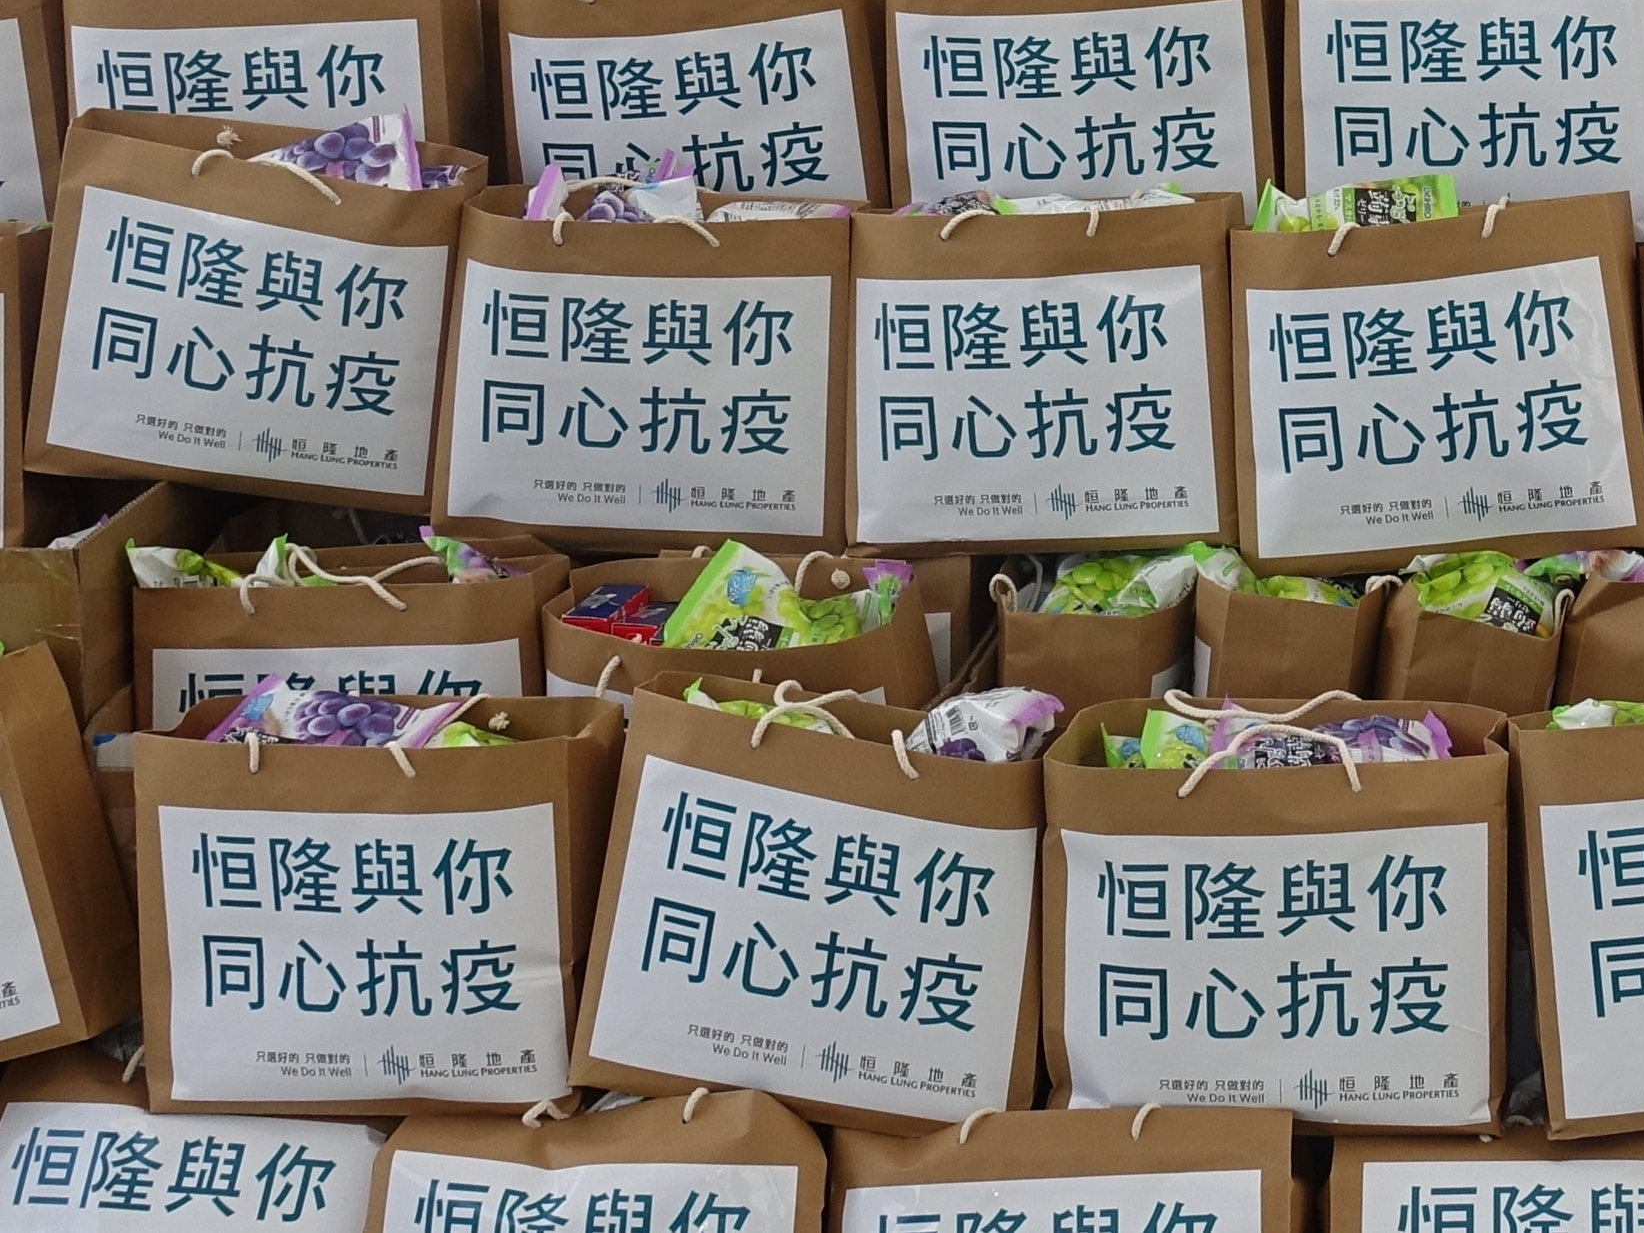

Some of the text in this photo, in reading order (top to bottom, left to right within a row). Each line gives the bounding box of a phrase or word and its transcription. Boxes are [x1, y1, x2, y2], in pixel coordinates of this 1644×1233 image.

[97, 44, 385, 112] 恒隆與你
[531, 41, 816, 121] 恒隆與你
[924, 26, 1211, 99] 恒隆與你
[1328, 16, 1617, 83] 恒隆與你
[932, 107, 1219, 182] 同心抗疫
[1334, 101, 1621, 168] 同心抗疫
[106, 216, 407, 329] 恒隆與你
[92, 307, 399, 416] 同心抗疫
[483, 289, 793, 366] 恒隆與你
[875, 295, 1167, 371] 恒隆與你
[1270, 290, 1573, 382] 恒隆與你
[482, 380, 790, 455] 同心抗疫
[880, 384, 1174, 461] 同心抗疫
[1279, 379, 1588, 473] 同心抗疫
[558, 493, 574, 502] We
[577, 494, 592, 503] Do
[604, 495, 626, 504] Well
[692, 487, 795, 503] 恒隆地產
[692, 500, 796, 511] HANG LUNG PROPERTIES
[1366, 511, 1434, 525] We Do It Well
[1498, 481, 1603, 505] 恒隆地產
[1500, 495, 1605, 514] HANG LUNG PROPERTIES
[192, 833, 513, 915] 恒隆與你
[662, 792, 995, 927] 恒隆與你
[1098, 855, 1447, 940] 恒隆與你
[203, 935, 519, 1016] 同心抗疫
[642, 897, 982, 1032] 同心抗疫
[1100, 957, 1448, 1040] 同心抗疫
[712, 1043, 788, 1067] We Do It Well
[859, 1071, 976, 1099] HANG LUNG PROPERTIES
[861, 1055, 976, 1090] 恒隆地產
[1340, 1073, 1458, 1092] 恒隆地產
[1187, 1093, 1265, 1103] We Do It Well
[1340, 1089, 1459, 1102] HANG LUNG PROPERTIES
[12, 1127, 336, 1222] 恒隆與你
